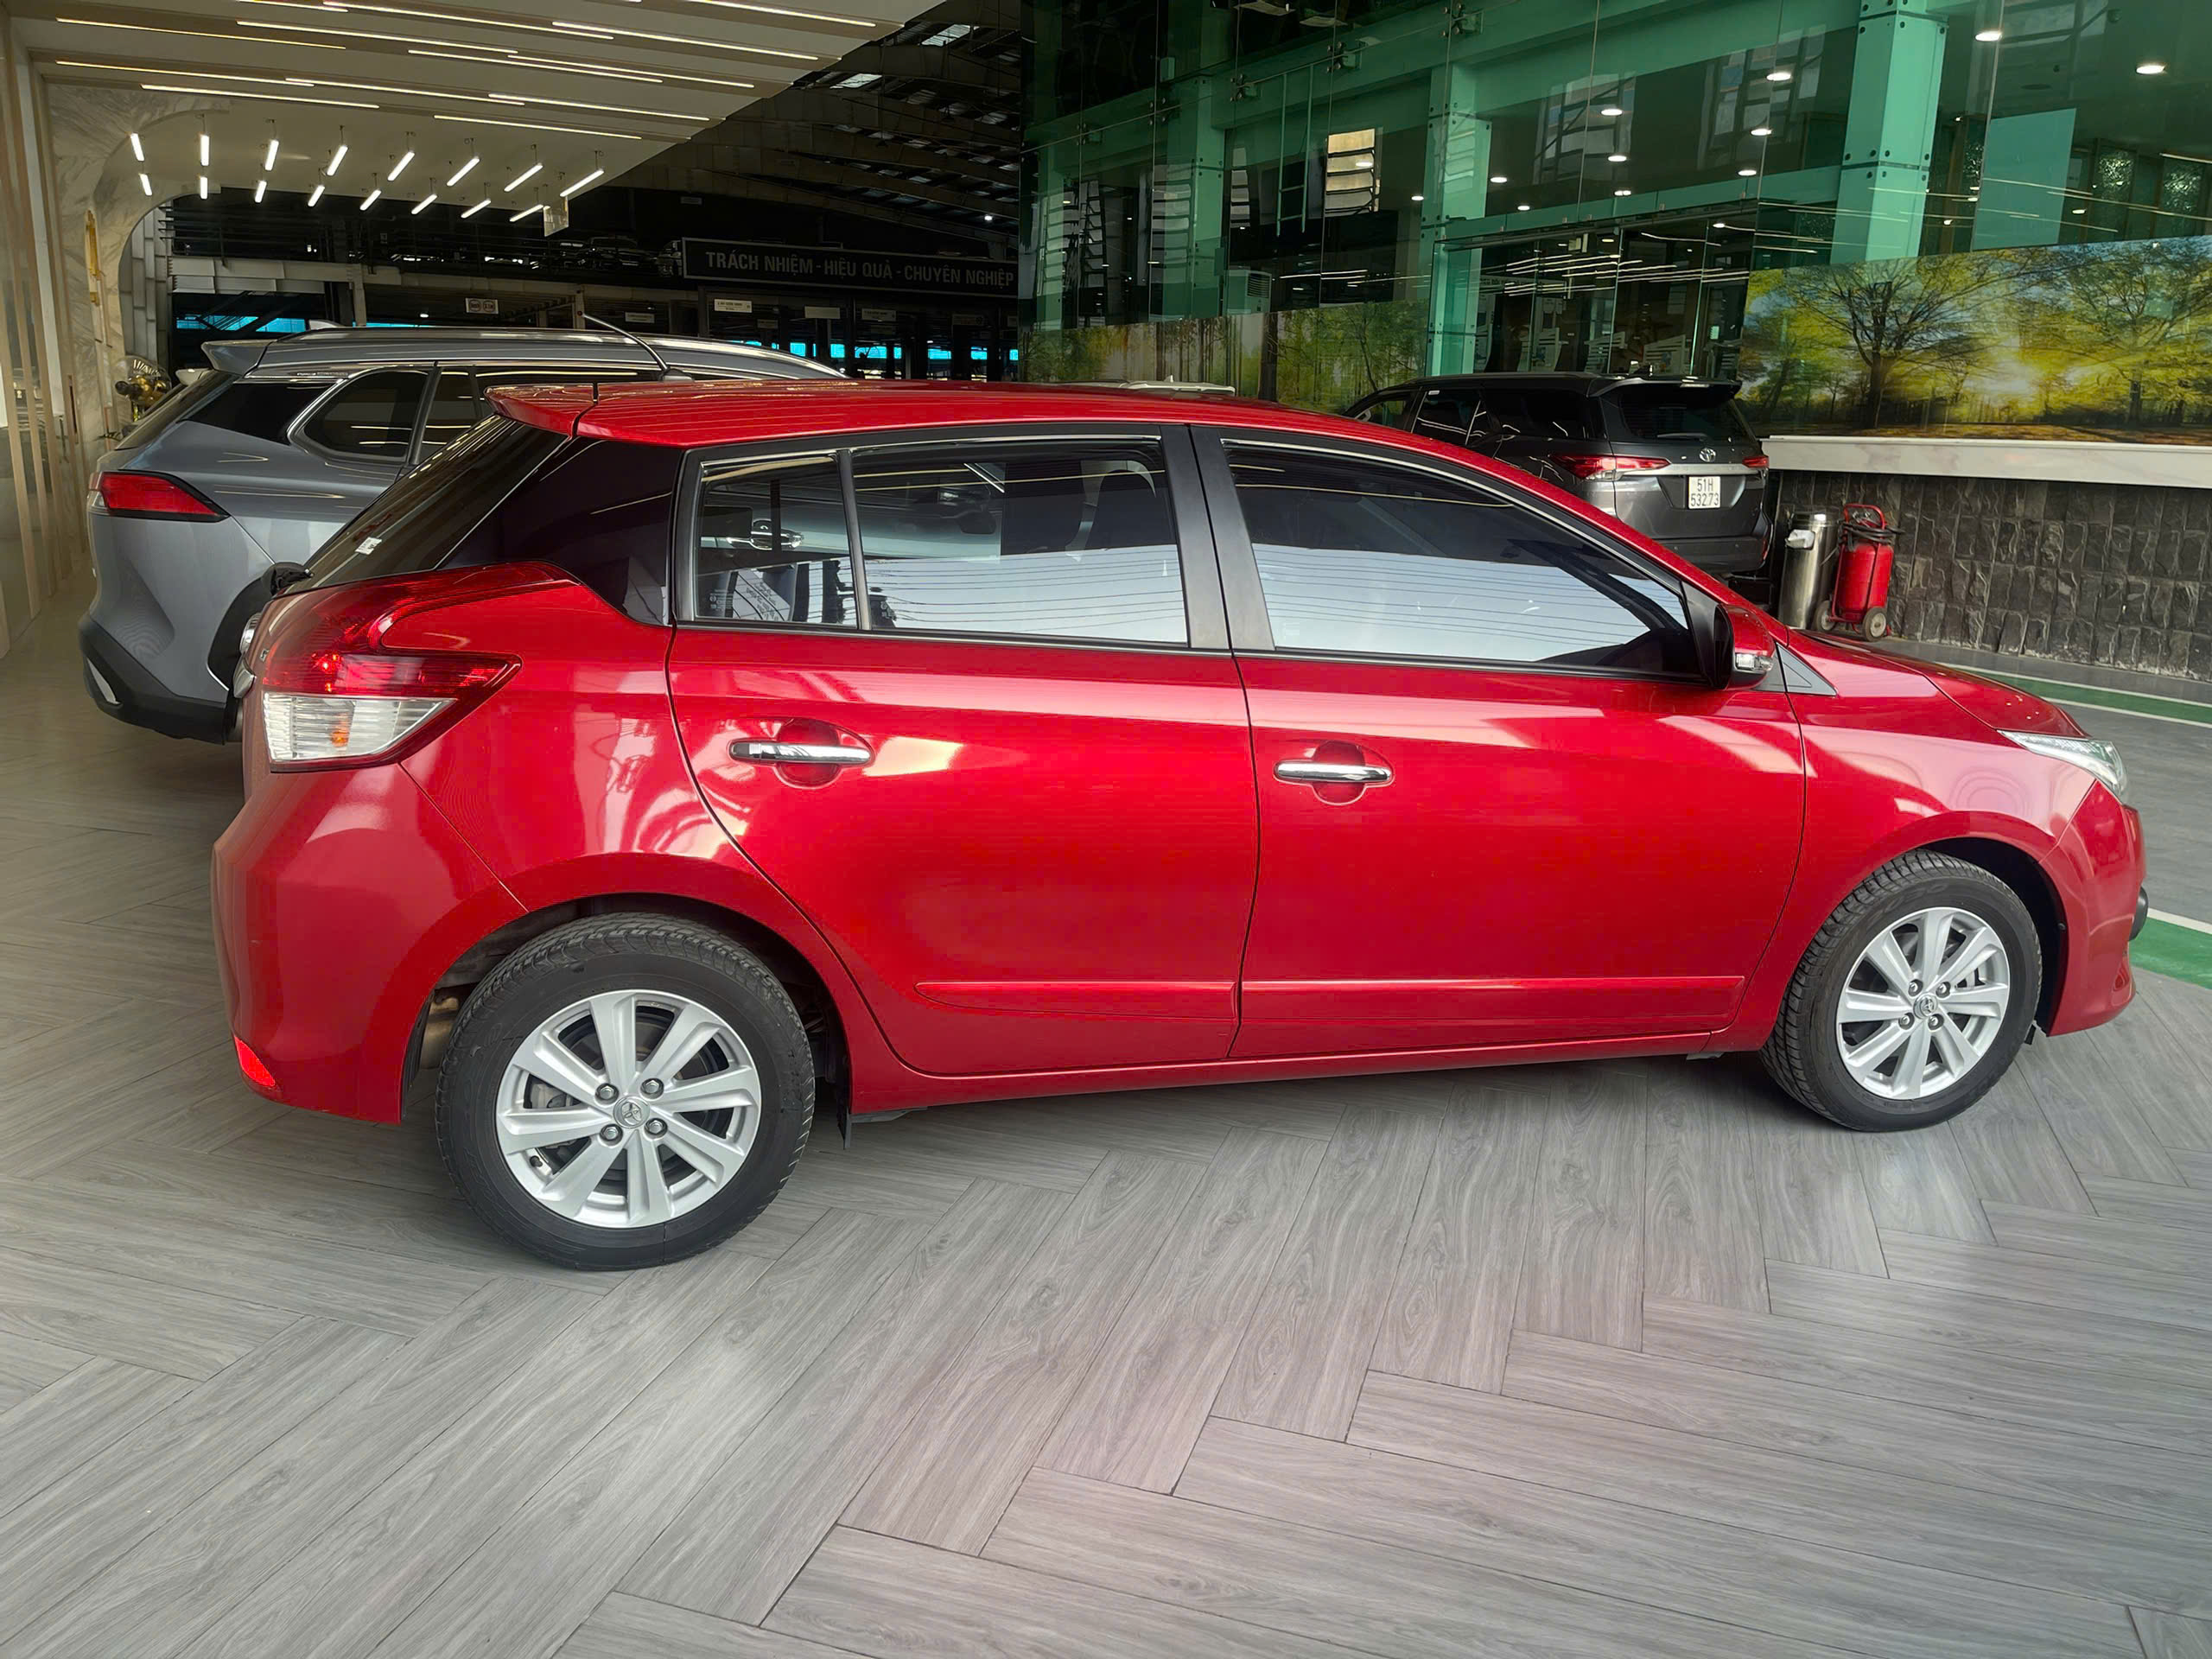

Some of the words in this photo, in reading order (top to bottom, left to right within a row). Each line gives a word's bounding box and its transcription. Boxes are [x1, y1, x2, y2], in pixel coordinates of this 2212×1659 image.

[704, 248, 760, 270] TRÁCH
[764, 252, 814, 276] NHIỆM
[824, 257, 856, 279] HIỆU
[904, 264, 962, 284] CHUYÊN
[965, 268, 1014, 289] NGHIỆP
[1697, 477, 1713, 492] 51H
[1690, 492, 1719, 507] 53273
